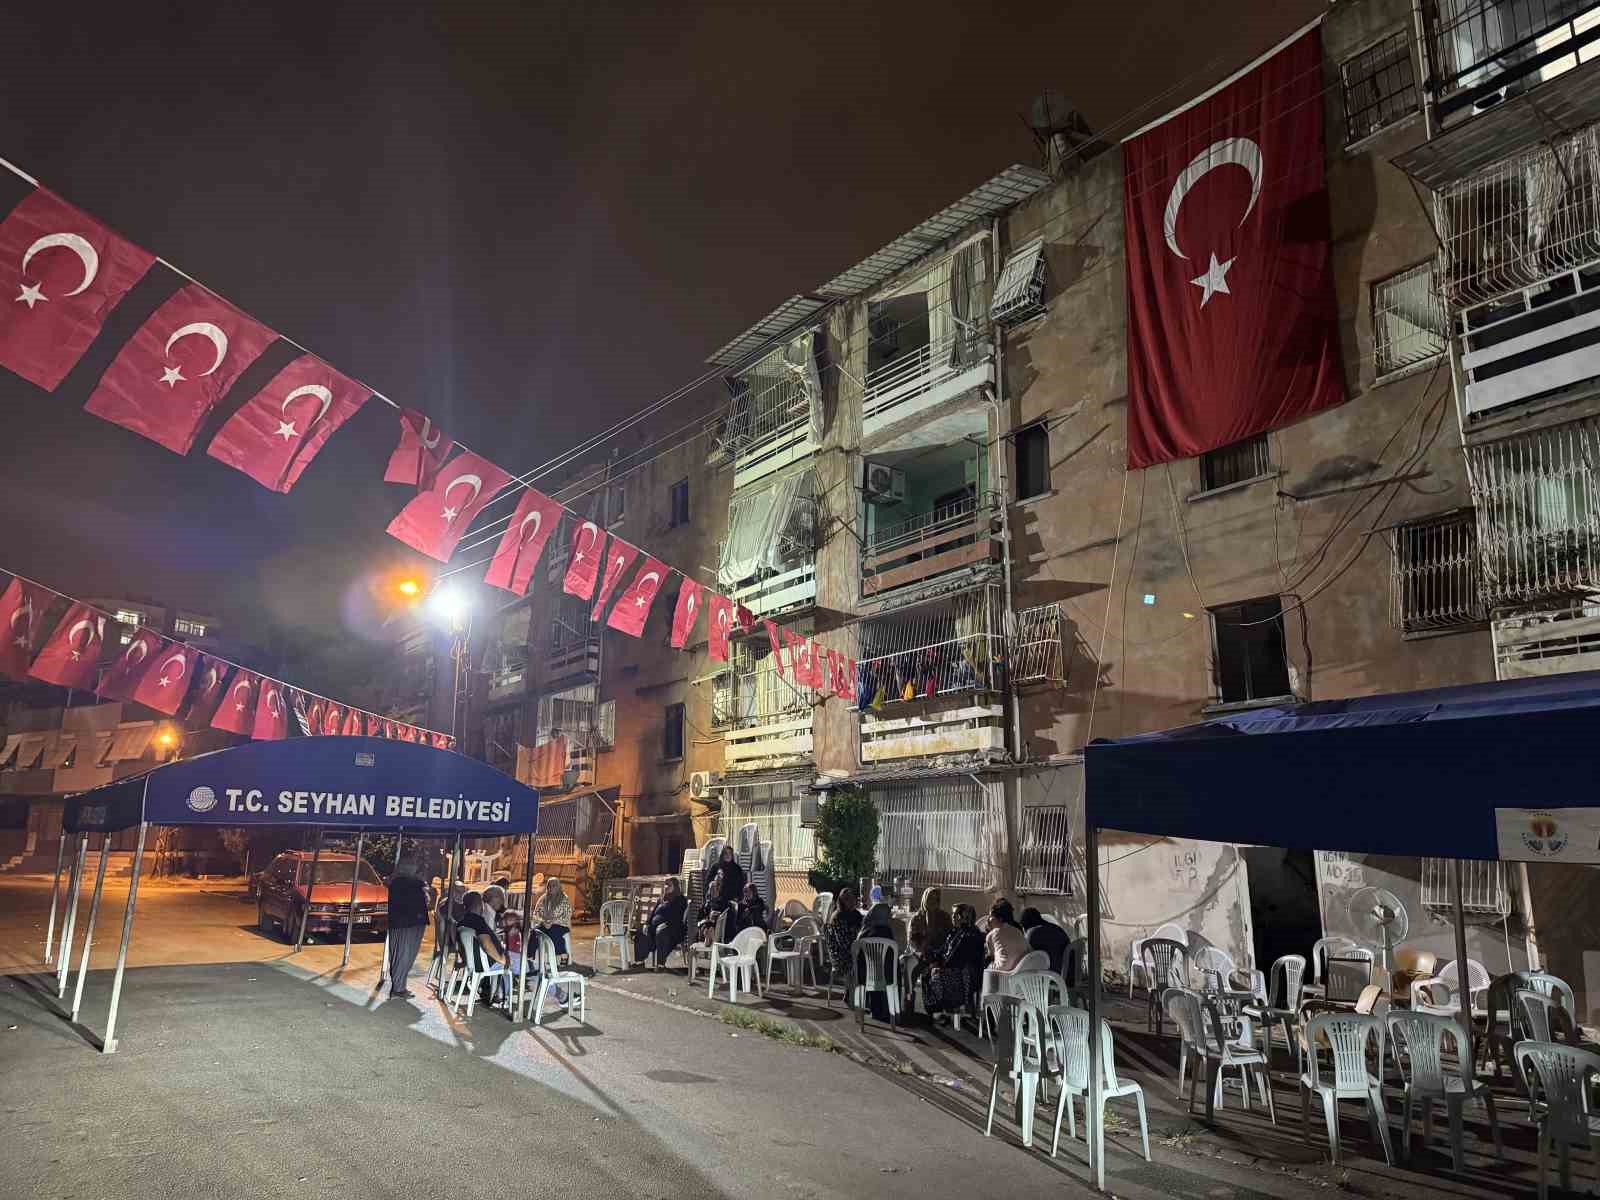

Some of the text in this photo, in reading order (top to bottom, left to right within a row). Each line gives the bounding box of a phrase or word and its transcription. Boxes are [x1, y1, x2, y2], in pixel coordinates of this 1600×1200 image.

[226, 789, 511, 823] T.C. SEYHAN BELEDİYESİ
